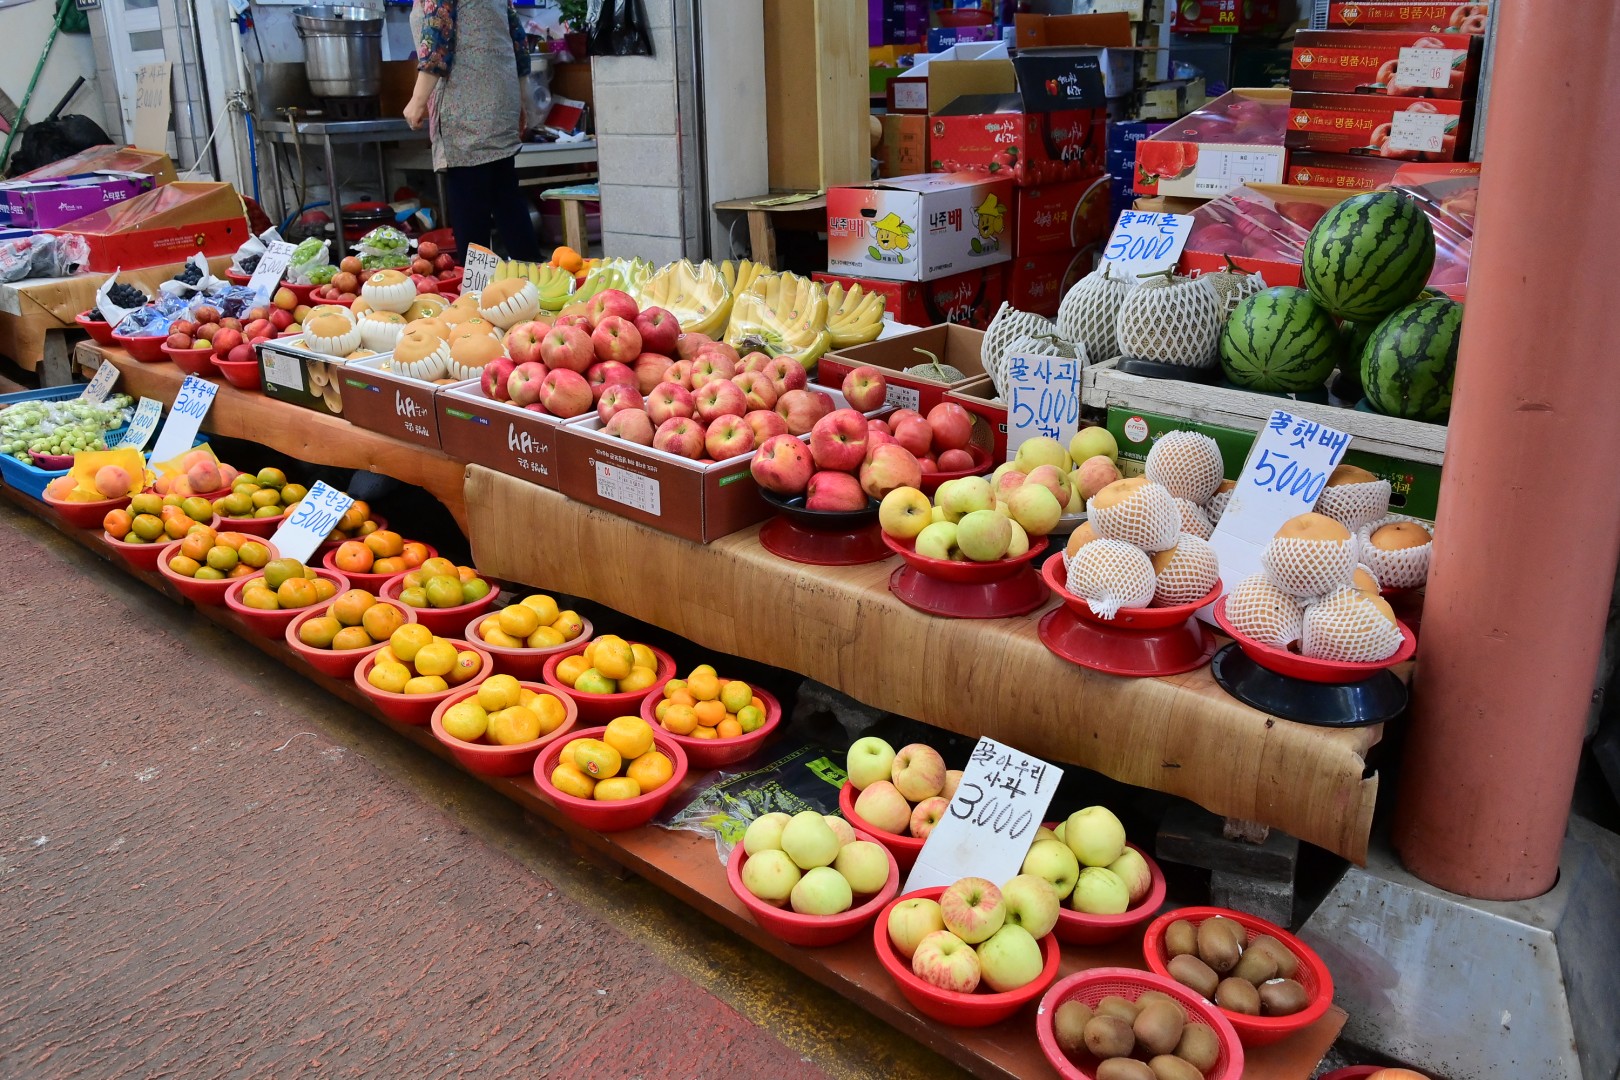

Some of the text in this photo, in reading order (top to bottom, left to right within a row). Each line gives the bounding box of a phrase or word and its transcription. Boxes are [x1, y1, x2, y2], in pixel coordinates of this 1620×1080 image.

[1400, 6, 1447, 19] 명품사과
[1340, 56, 1380, 68] 명품사과
[1335, 117, 1374, 130] 명품사과
[994, 133, 1018, 143] 사과
[1060, 145, 1084, 161] 사과
[1336, 176, 1375, 189] 명품사과
[102, 189, 127, 202] 스타포도
[830, 217, 865, 238] 나주배
[929, 208, 962, 232] 나주배
[1120, 210, 1179, 235] 꿀메론
[1104, 234, 1175, 262] 3.000
[258, 256, 283, 275] 5.000
[183, 376, 217, 398] 꿀복숭아
[1009, 357, 1081, 393] 꿀사과
[174, 393, 207, 419] 3.000
[1014, 387, 1079, 429] 5.000
[1270, 411, 1348, 466] 꿀햇배
[1254, 449, 1326, 503] 5.000
[311, 482, 351, 513] 꿀단감
[290, 500, 338, 537] 3.000
[950, 783, 1033, 839] 3.000
